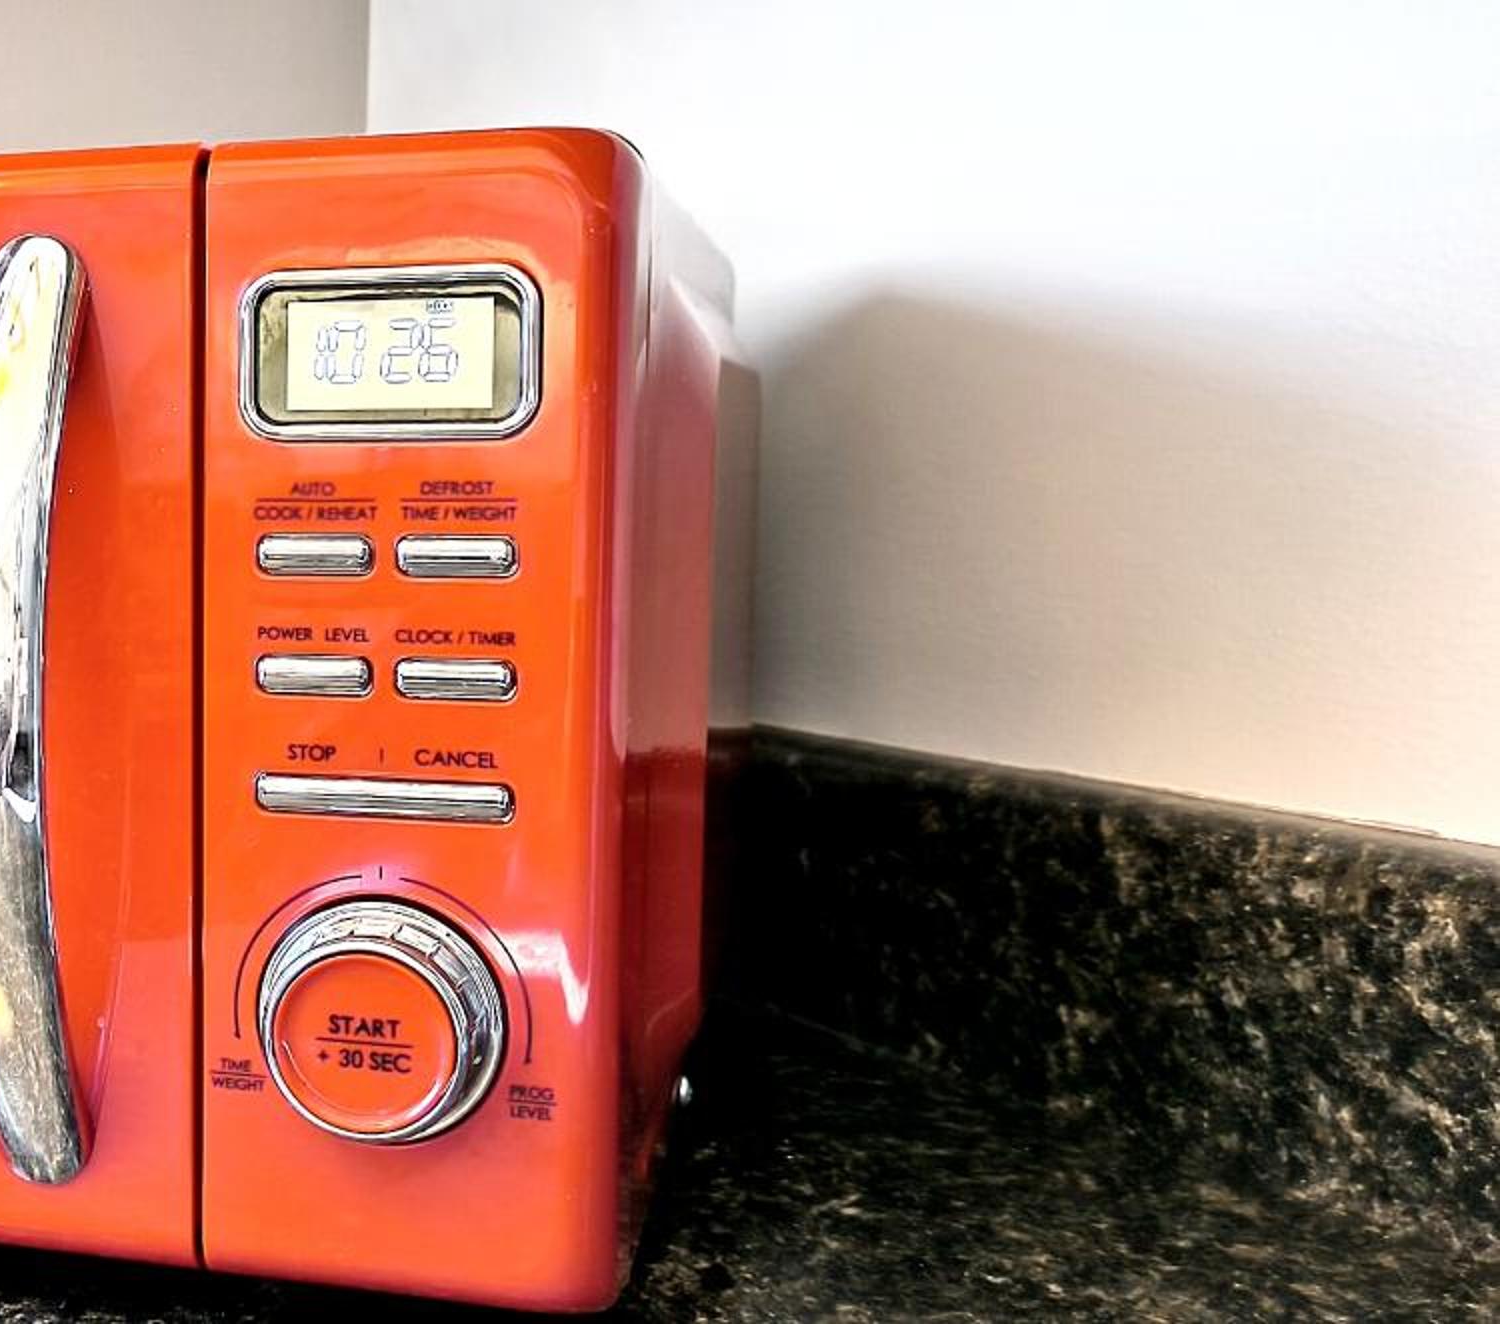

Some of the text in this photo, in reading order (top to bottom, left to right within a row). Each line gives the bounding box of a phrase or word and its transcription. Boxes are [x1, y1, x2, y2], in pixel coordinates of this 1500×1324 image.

[290, 482, 336, 497] AUTO
[420, 481, 495, 496] DEFROST
[254, 506, 302, 521] COOK
[316, 506, 378, 521] REHEAT
[402, 507, 438, 521] TIME
[453, 506, 517, 522] WEIGHT
[257, 626, 369, 643] POWER LEVEL
[395, 629, 453, 645] CLOCK
[467, 631, 517, 647] TIMER
[286, 744, 499, 770] STOP CANCEL
[328, 1014, 401, 1038] START
[219, 1057, 252, 1073] TIME
[339, 1050, 365, 1069] 30
[368, 1052, 413, 1075] SEC
[211, 1077, 266, 1093] WEIGHT
[508, 1086, 555, 1101] PROG
[509, 1105, 553, 1121] LEVEL
